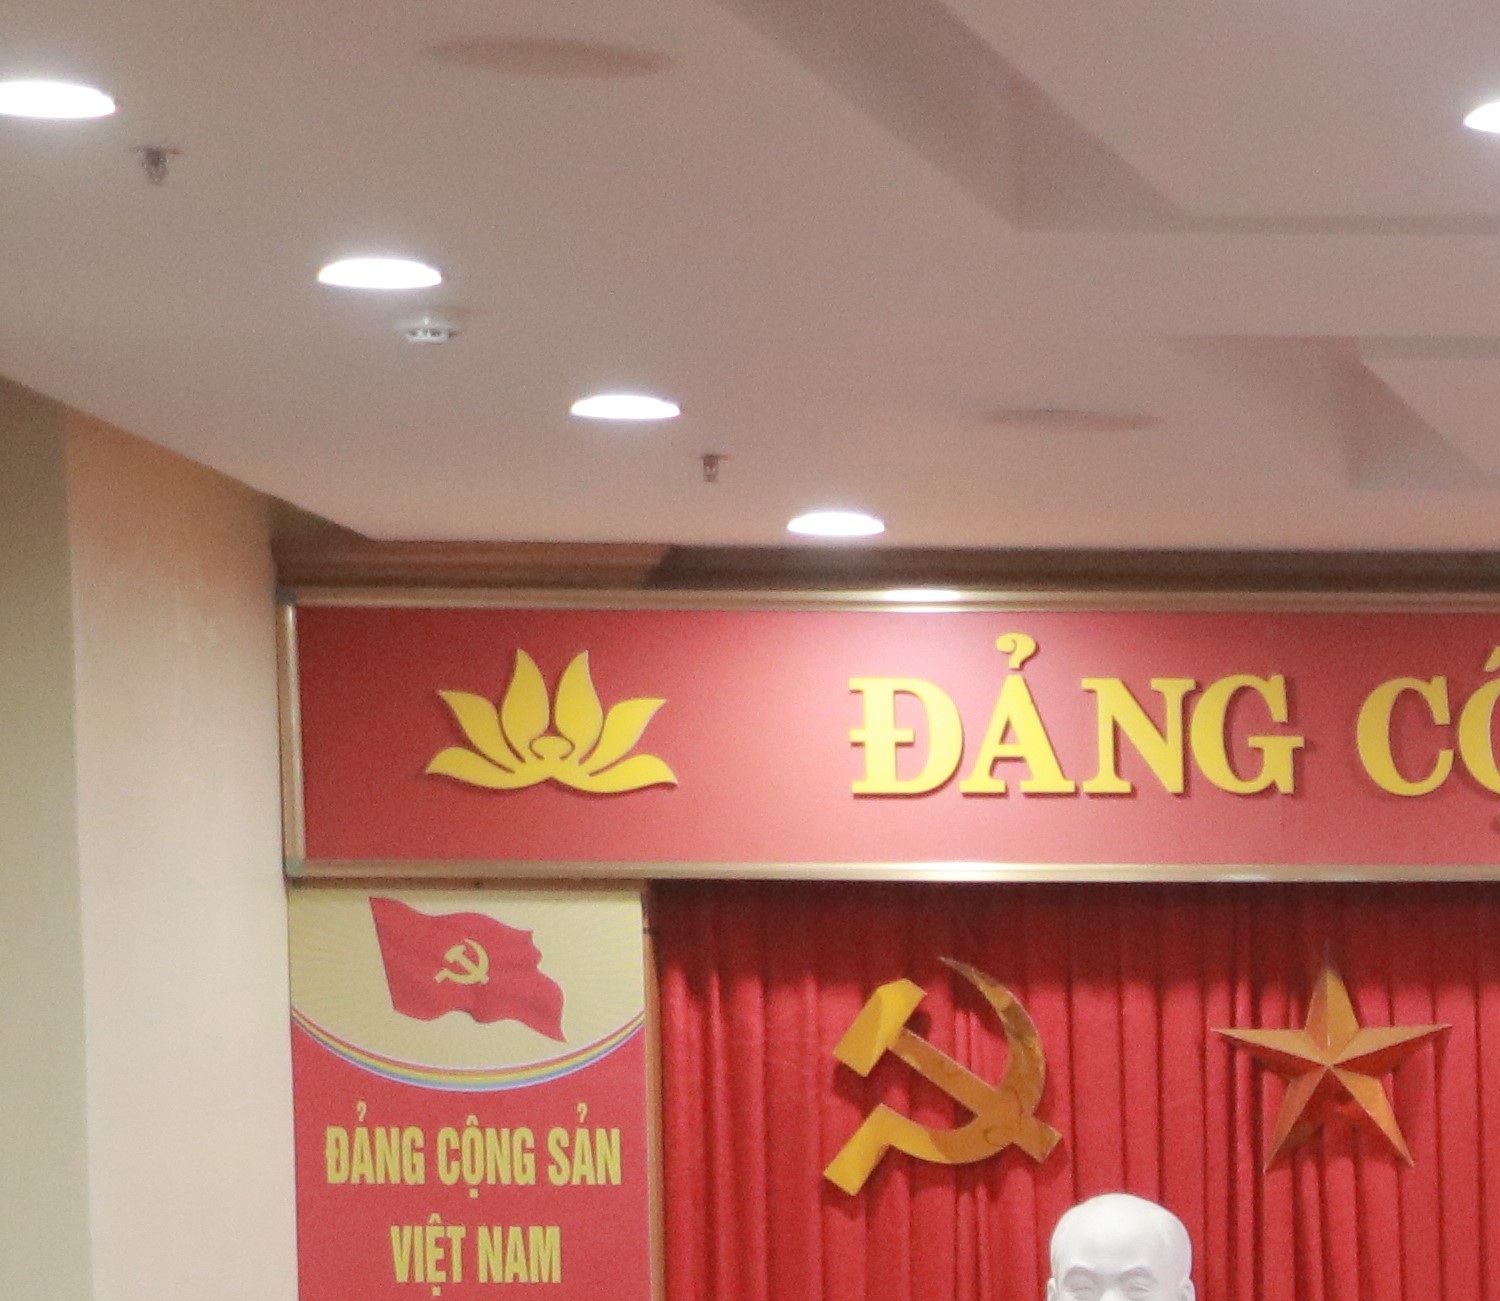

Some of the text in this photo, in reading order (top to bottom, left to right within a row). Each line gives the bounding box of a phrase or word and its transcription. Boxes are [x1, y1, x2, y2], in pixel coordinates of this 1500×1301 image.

[848, 632, 1303, 794] ĐẢNG
[325, 1101, 621, 1198] ĐẢNG CỘNG SẢN
[390, 1213, 561, 1296] VIỆT NAM
